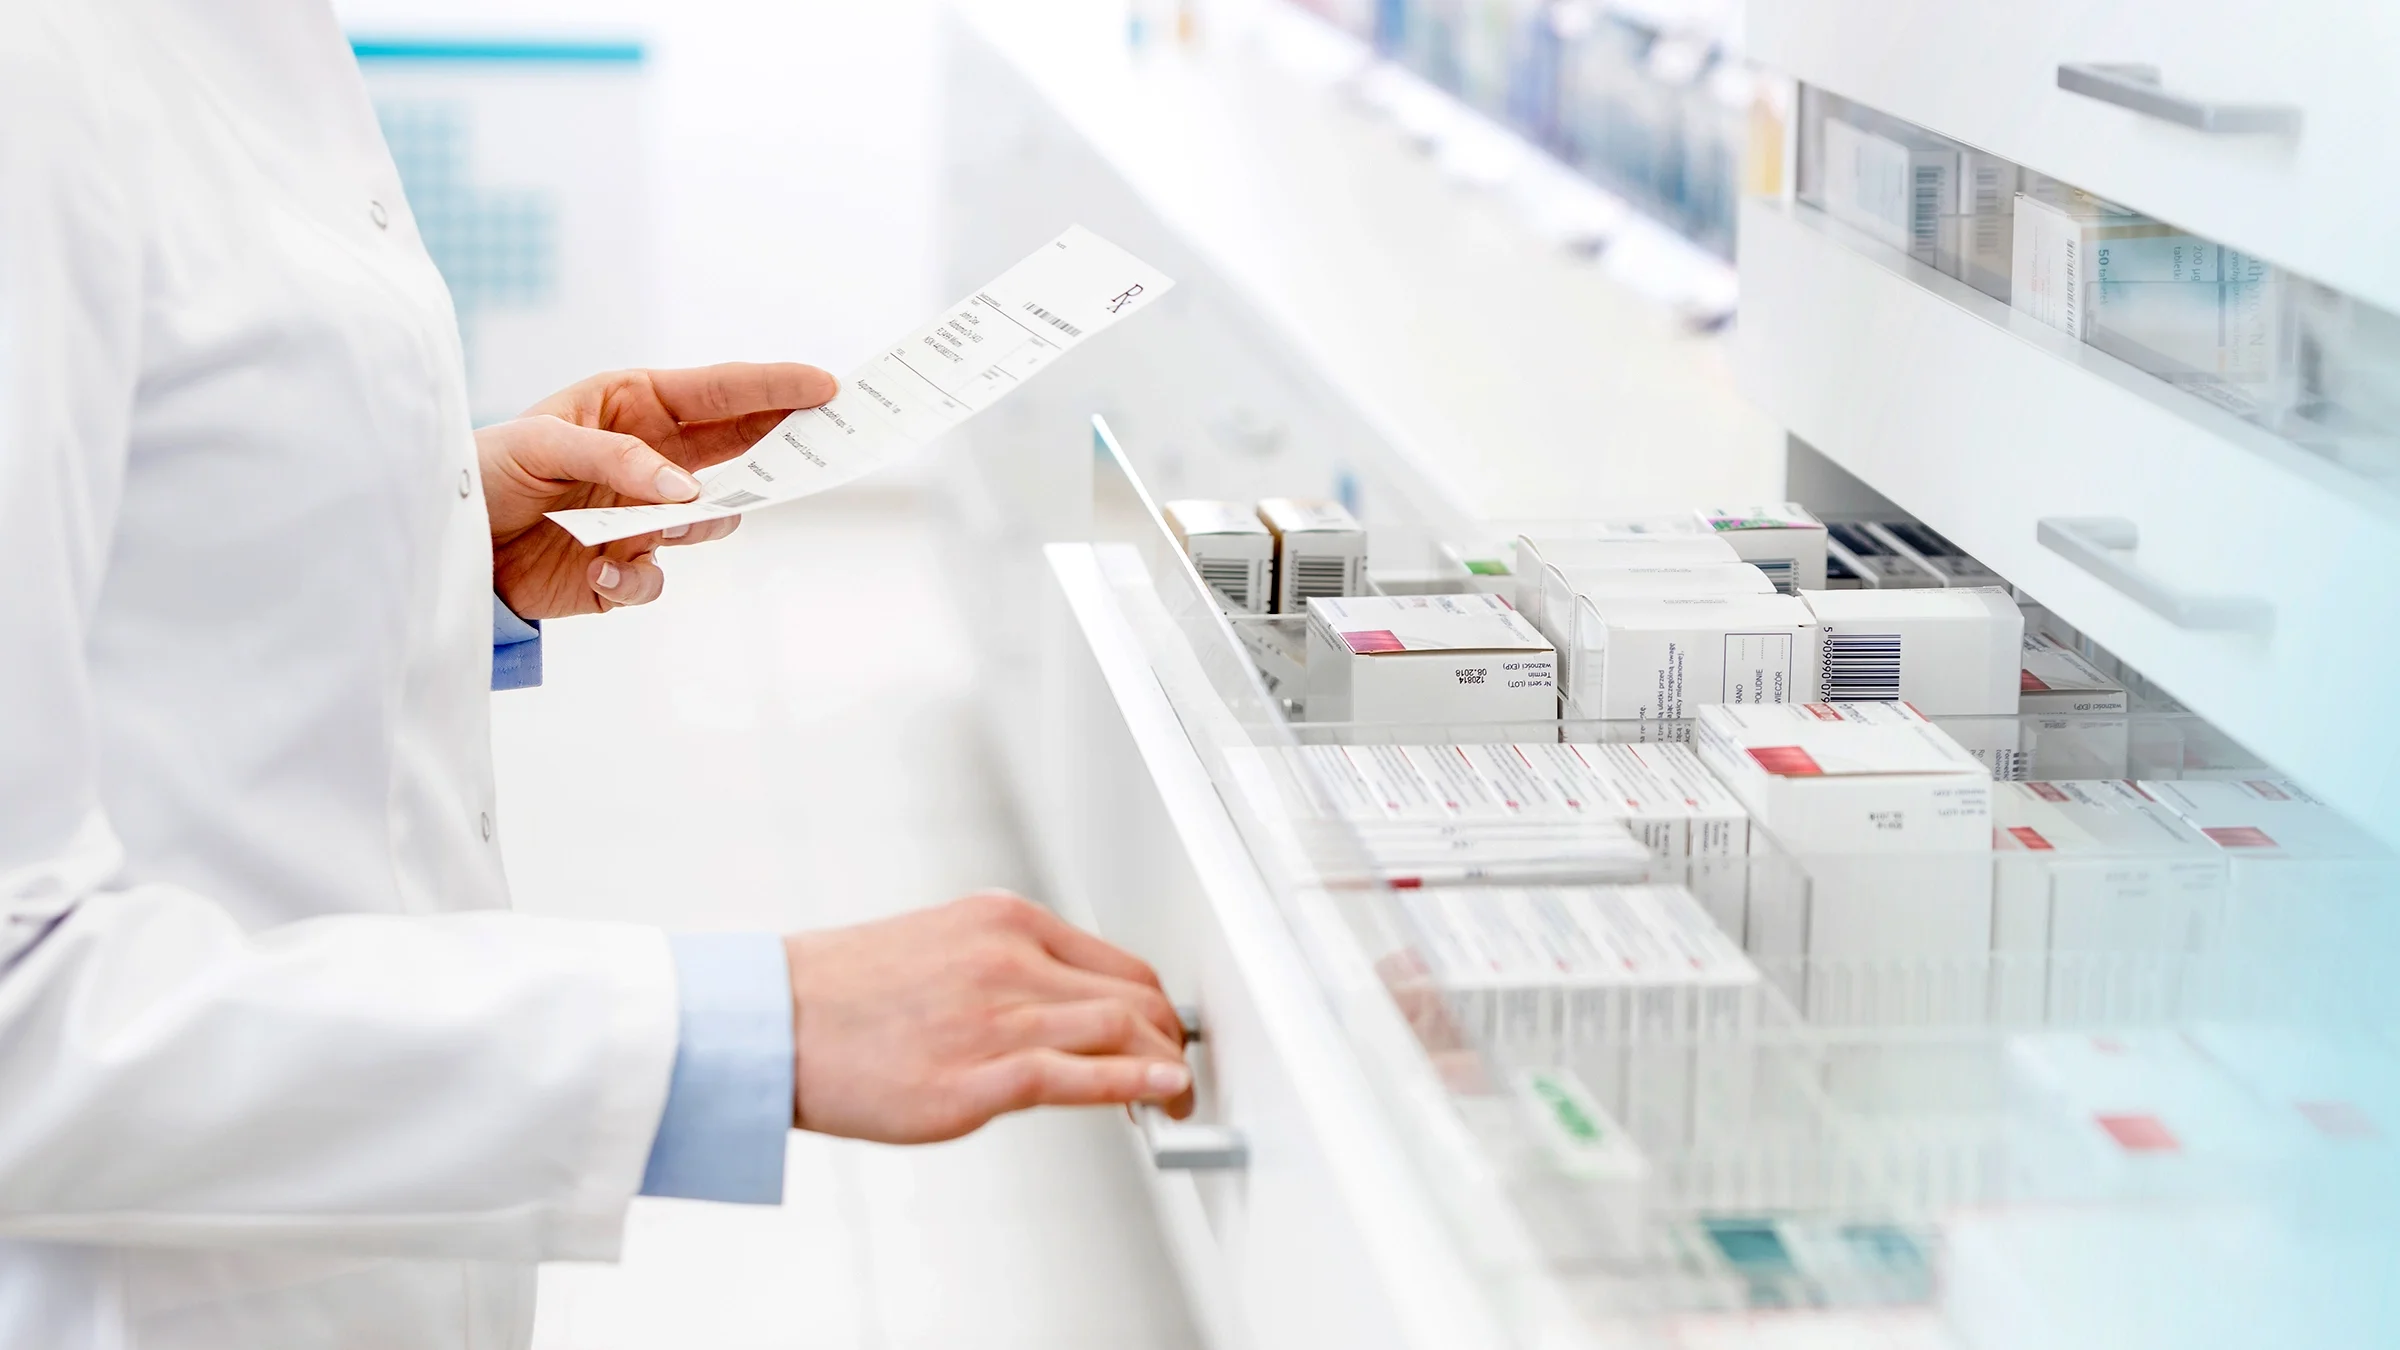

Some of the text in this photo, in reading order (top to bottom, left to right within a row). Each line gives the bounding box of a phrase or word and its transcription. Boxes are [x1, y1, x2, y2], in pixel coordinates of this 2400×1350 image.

[2098, 249, 2109, 266] 50
[2173, 246, 2182, 280] tabletki
[2193, 245, 2203, 266] 200
[1668, 642, 1676, 665] uwagę
[1821, 639, 1832, 679] 909990
[1455, 668, 1487, 677] 08.2018
[1503, 662, 1551, 670] ważności (EXP)
[1458, 676, 1485, 684] 120814
[1508, 680, 1526, 688] (LOT)
[1667, 666, 1675, 702] szczególną
[1754, 669, 1763, 704] POŁUDNIE
[1773, 671, 1782, 704] WIECZÓR
[1735, 684, 1743, 704] RANO
[2073, 702, 2122, 710] ważności (EXP)
